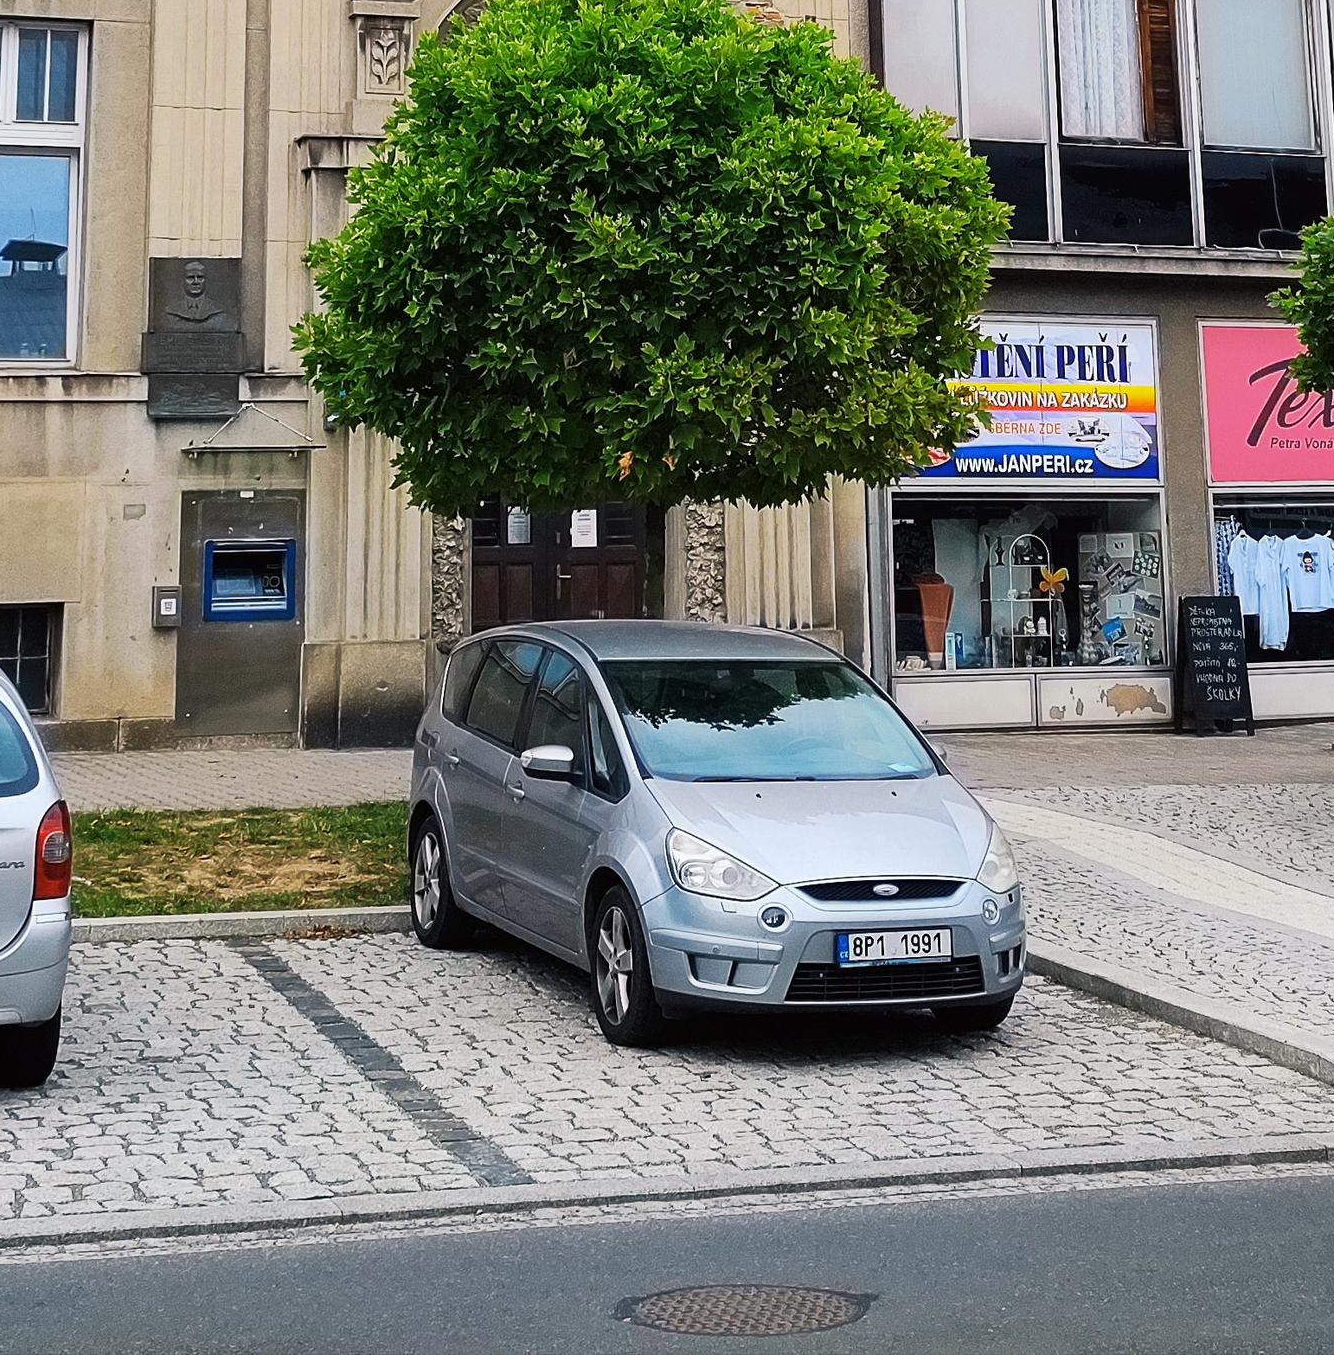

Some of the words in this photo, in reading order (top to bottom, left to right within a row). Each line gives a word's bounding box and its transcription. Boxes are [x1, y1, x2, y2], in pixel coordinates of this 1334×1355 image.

[976, 333, 1046, 380] TĚNÍ
[1055, 332, 1131, 383] PEŘÍ
[1038, 392, 1058, 407] NA
[1062, 389, 1128, 409] ZAKÁZKU
[1039, 422, 1061, 434] ZDE
[1270, 437, 1300, 449] Petra
[1207, 685, 1241, 701] ŠKOLKY
[839, 950, 849, 959] CZ
[852, 935, 885, 957] 8P1
[901, 932, 942, 955] 1991
